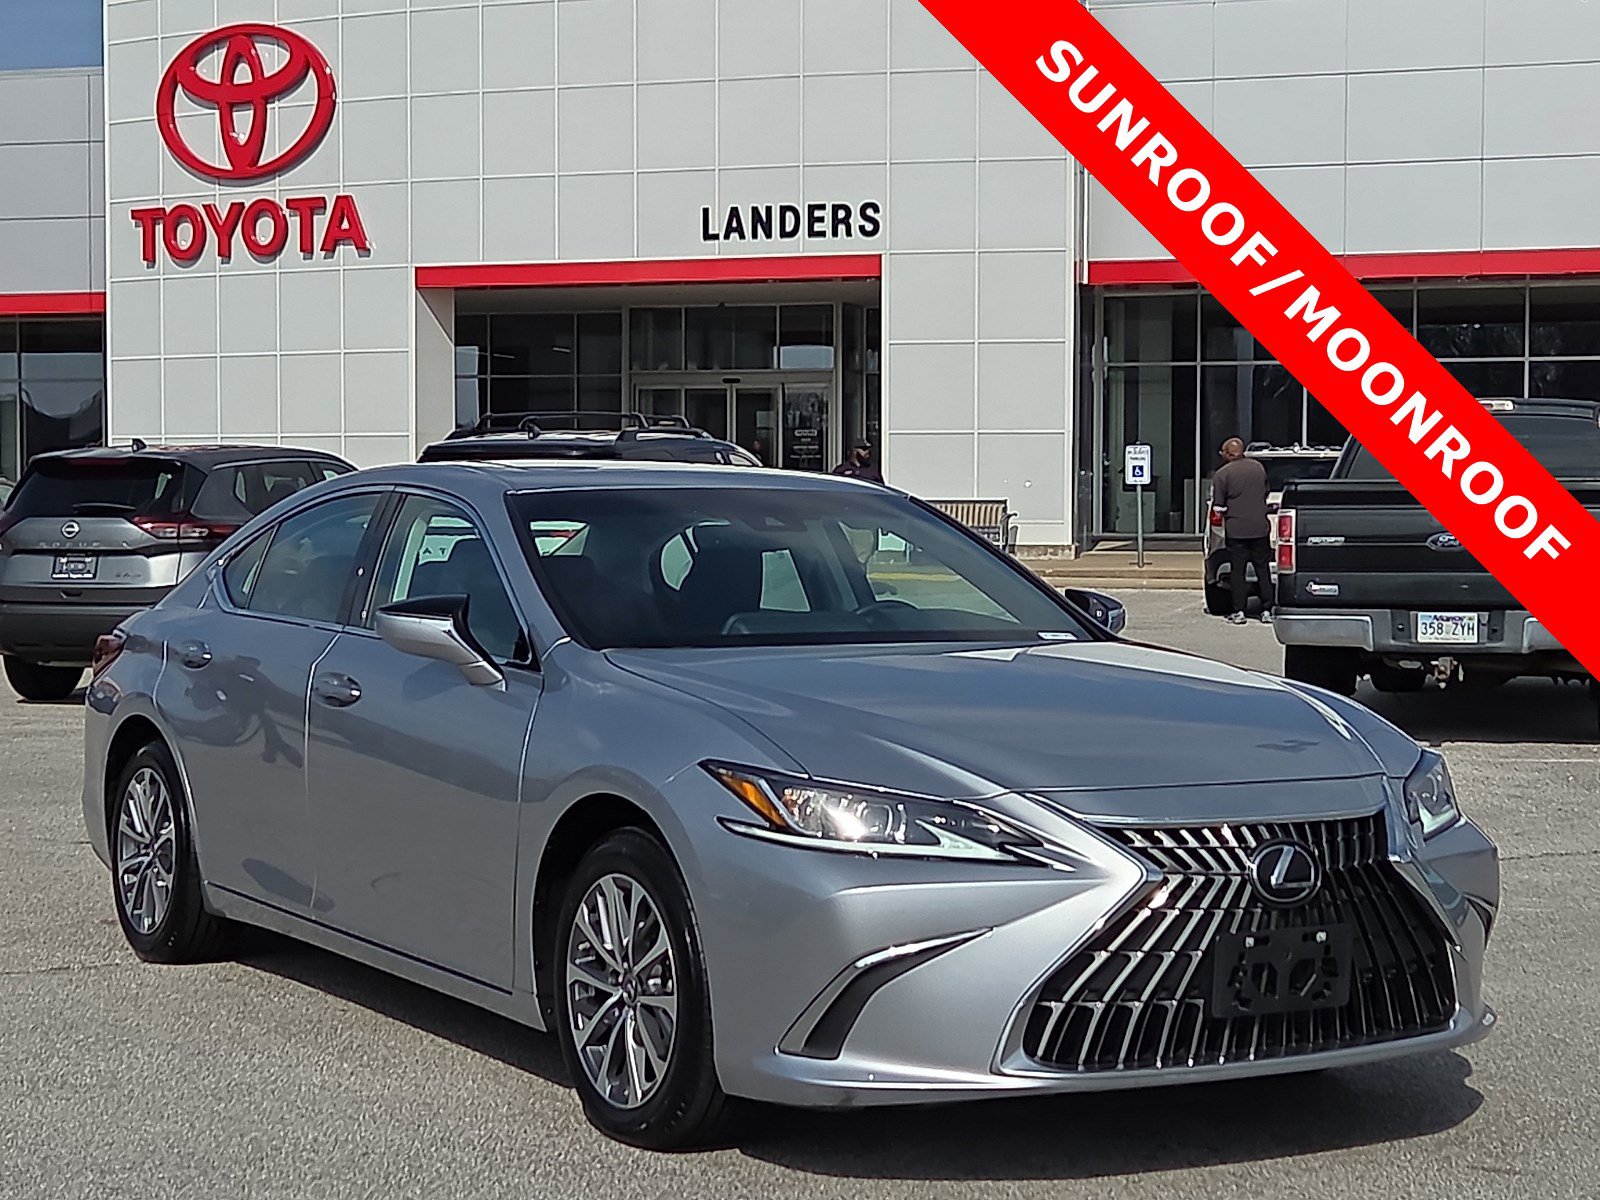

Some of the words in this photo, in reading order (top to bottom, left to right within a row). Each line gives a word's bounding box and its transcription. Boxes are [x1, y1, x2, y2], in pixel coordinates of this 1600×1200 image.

[131, 195, 369, 262] TOYOTA
[702, 202, 881, 241] LANDERS
[1421, 622, 1444, 636] 358
[1451, 622, 1475, 636] ZYH
